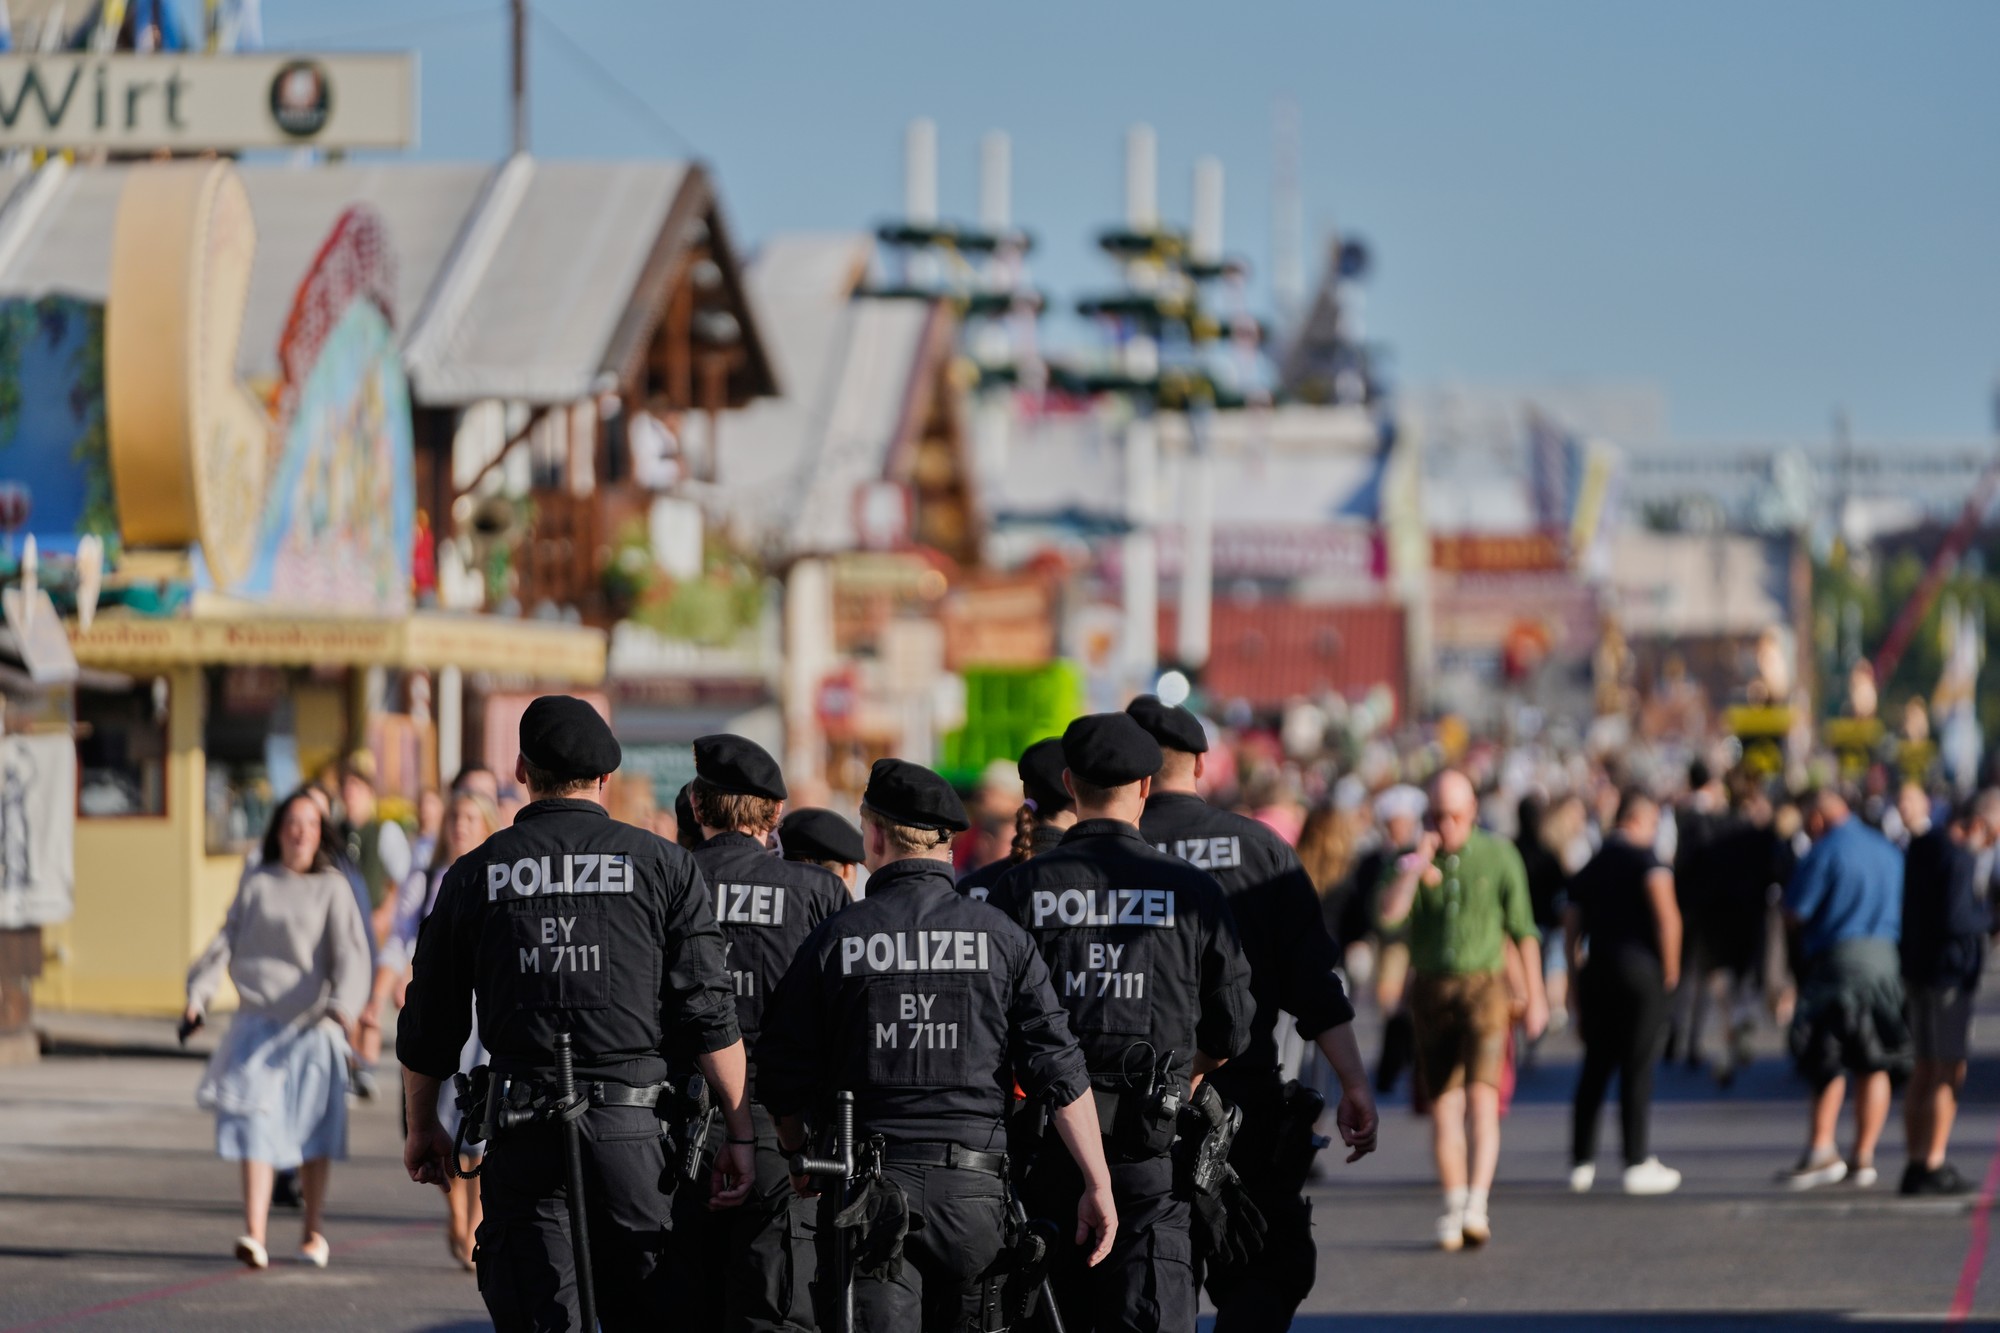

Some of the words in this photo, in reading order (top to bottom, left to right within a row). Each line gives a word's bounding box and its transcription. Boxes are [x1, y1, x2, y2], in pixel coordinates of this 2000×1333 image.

[0, 63, 191, 130] Wirt
[1157, 836, 1241, 869] IZEI
[488, 854, 634, 900] POLIZEI
[717, 884, 785, 925] IZEI
[1034, 889, 1175, 928] POLIZEI
[541, 917, 577, 944] BY
[520, 947, 540, 973] M
[551, 945, 600, 973] 7111
[842, 931, 989, 974] POLIZEI
[1089, 943, 1125, 969] BY
[725, 970, 754, 996] 11
[1065, 971, 1086, 997] M
[1097, 972, 1144, 999] 7111
[900, 994, 937, 1020] BY
[876, 1023, 897, 1049] M
[908, 1022, 958, 1049] 7111
